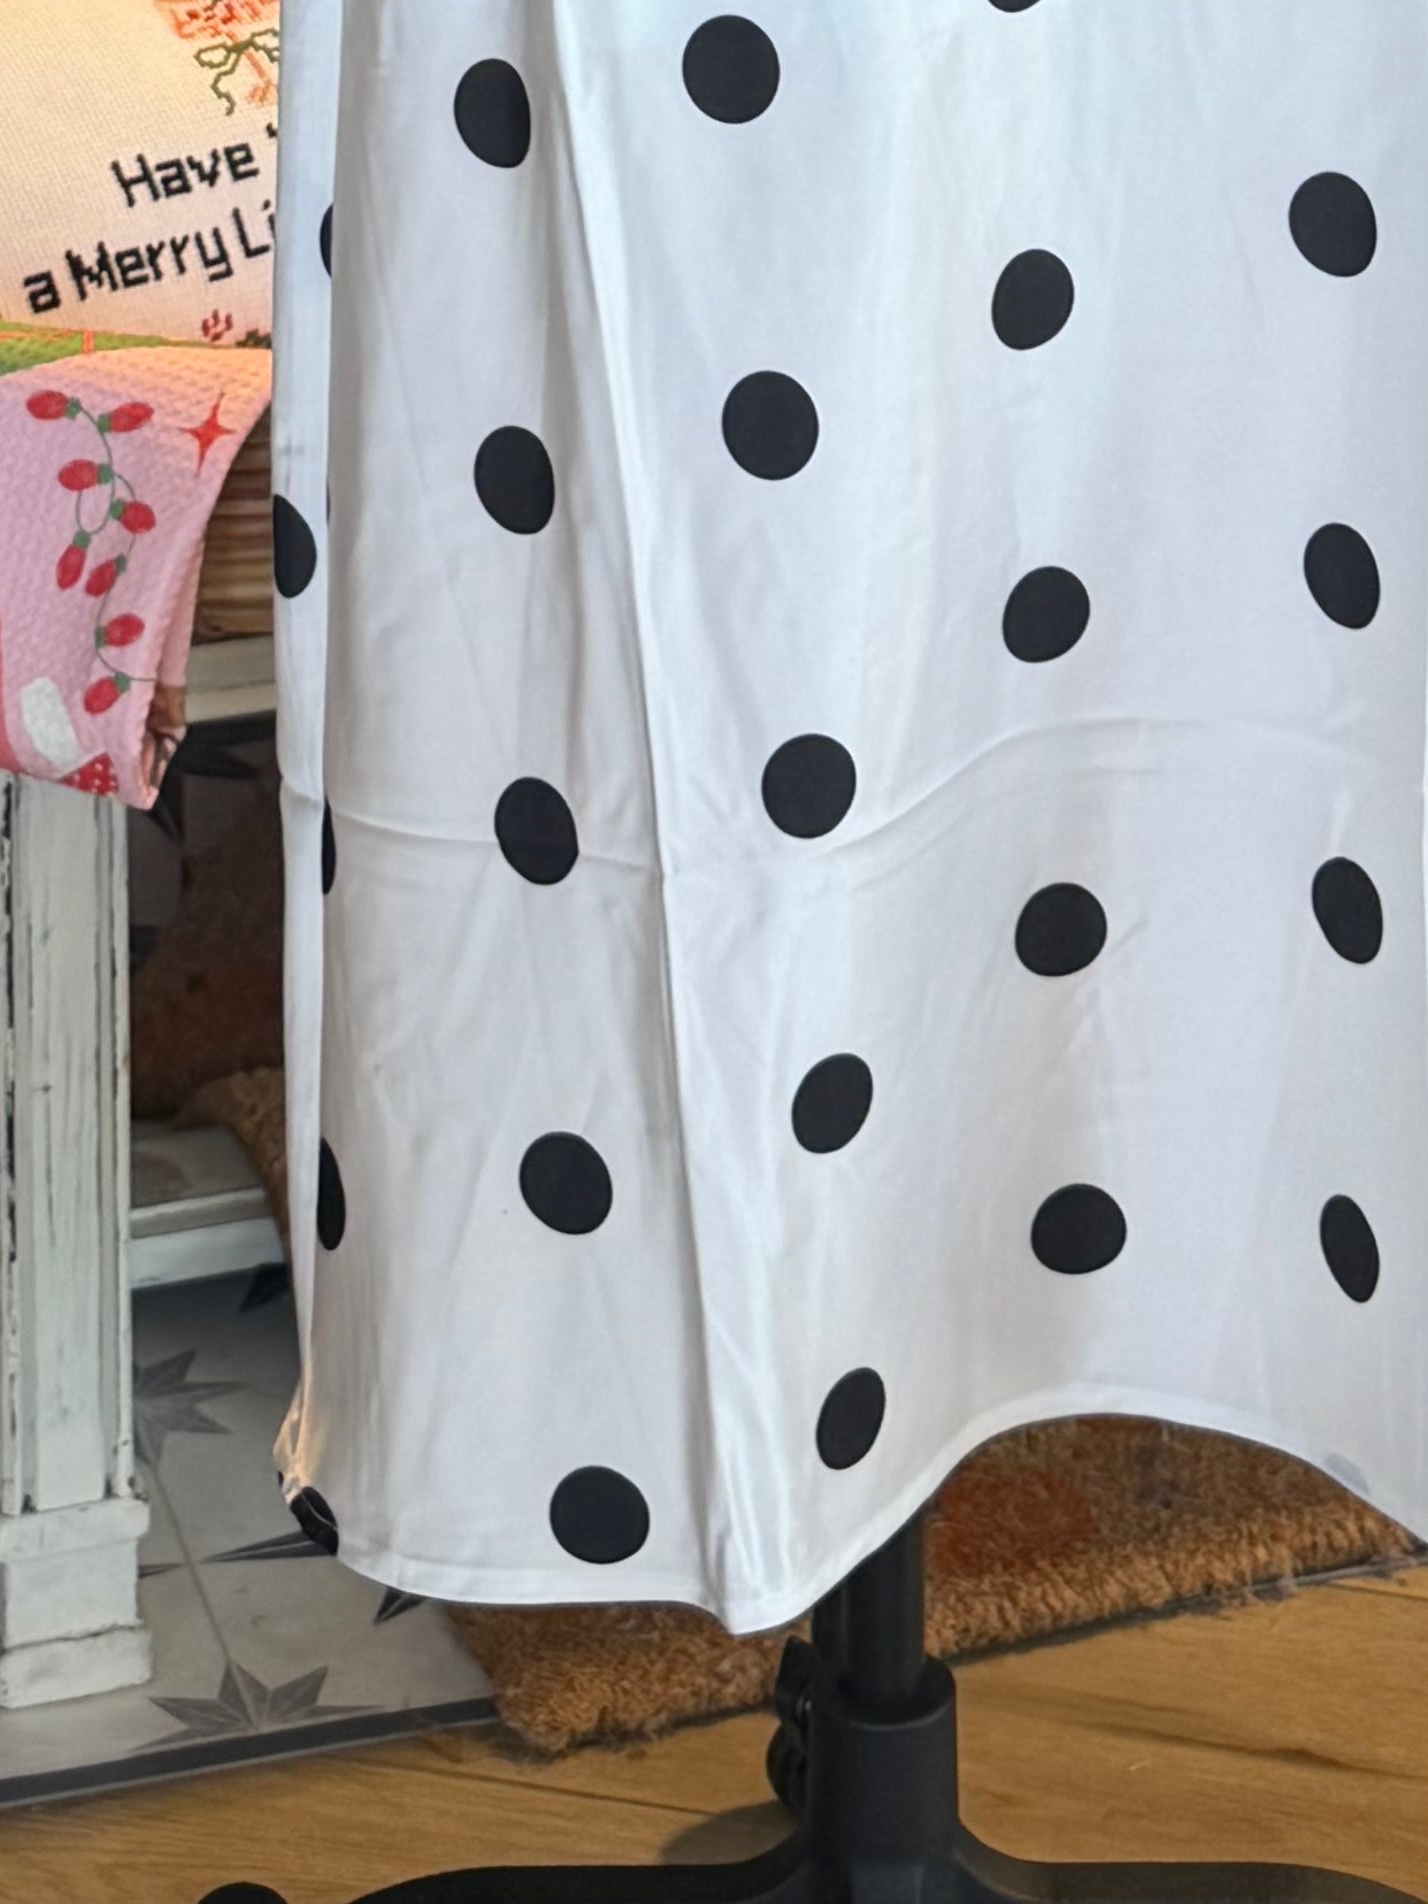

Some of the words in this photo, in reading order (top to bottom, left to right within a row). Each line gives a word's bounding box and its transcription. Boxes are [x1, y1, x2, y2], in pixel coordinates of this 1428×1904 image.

[111, 142, 260, 208] Have
[23, 270, 61, 313] a
[65, 226, 234, 302] Merry
[231, 199, 276, 259] Li
